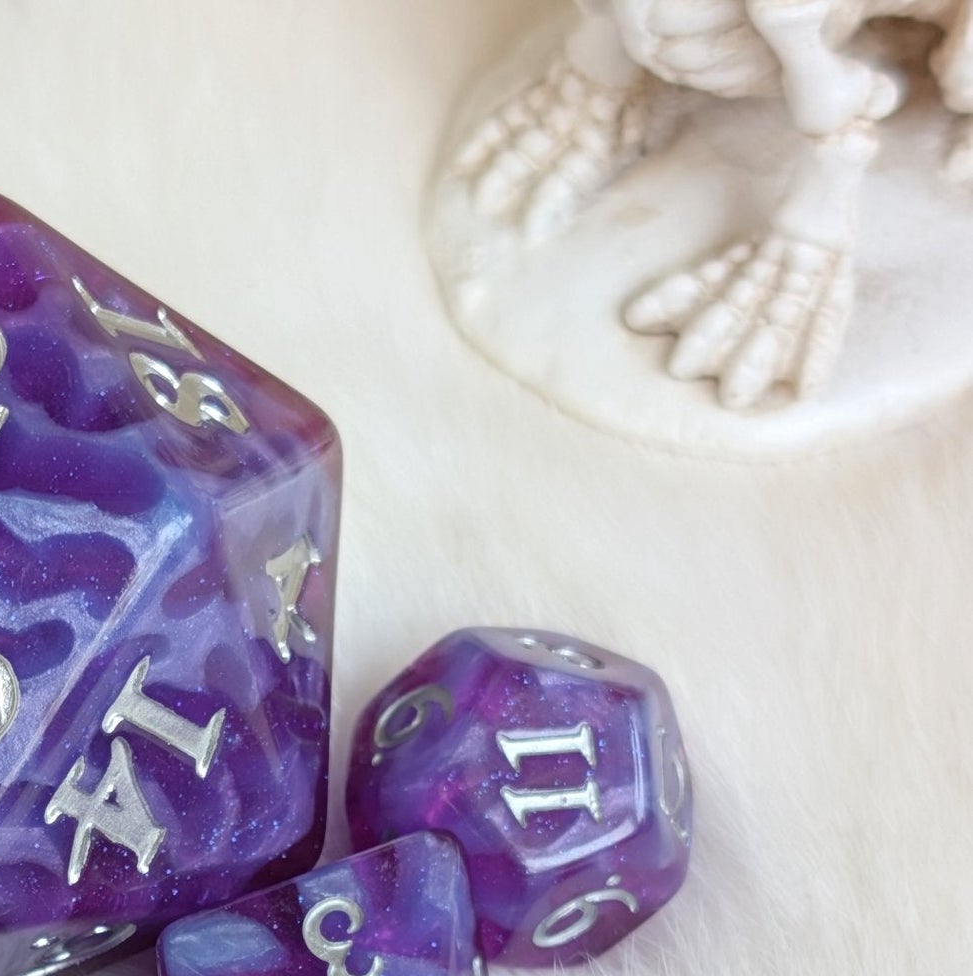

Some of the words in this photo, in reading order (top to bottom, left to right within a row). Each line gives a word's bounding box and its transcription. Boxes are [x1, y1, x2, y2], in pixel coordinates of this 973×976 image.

[72, 275, 251, 435] 18
[265, 533, 324, 663] 4
[43, 655, 226, 885] 14
[496, 721, 601, 828] 11
